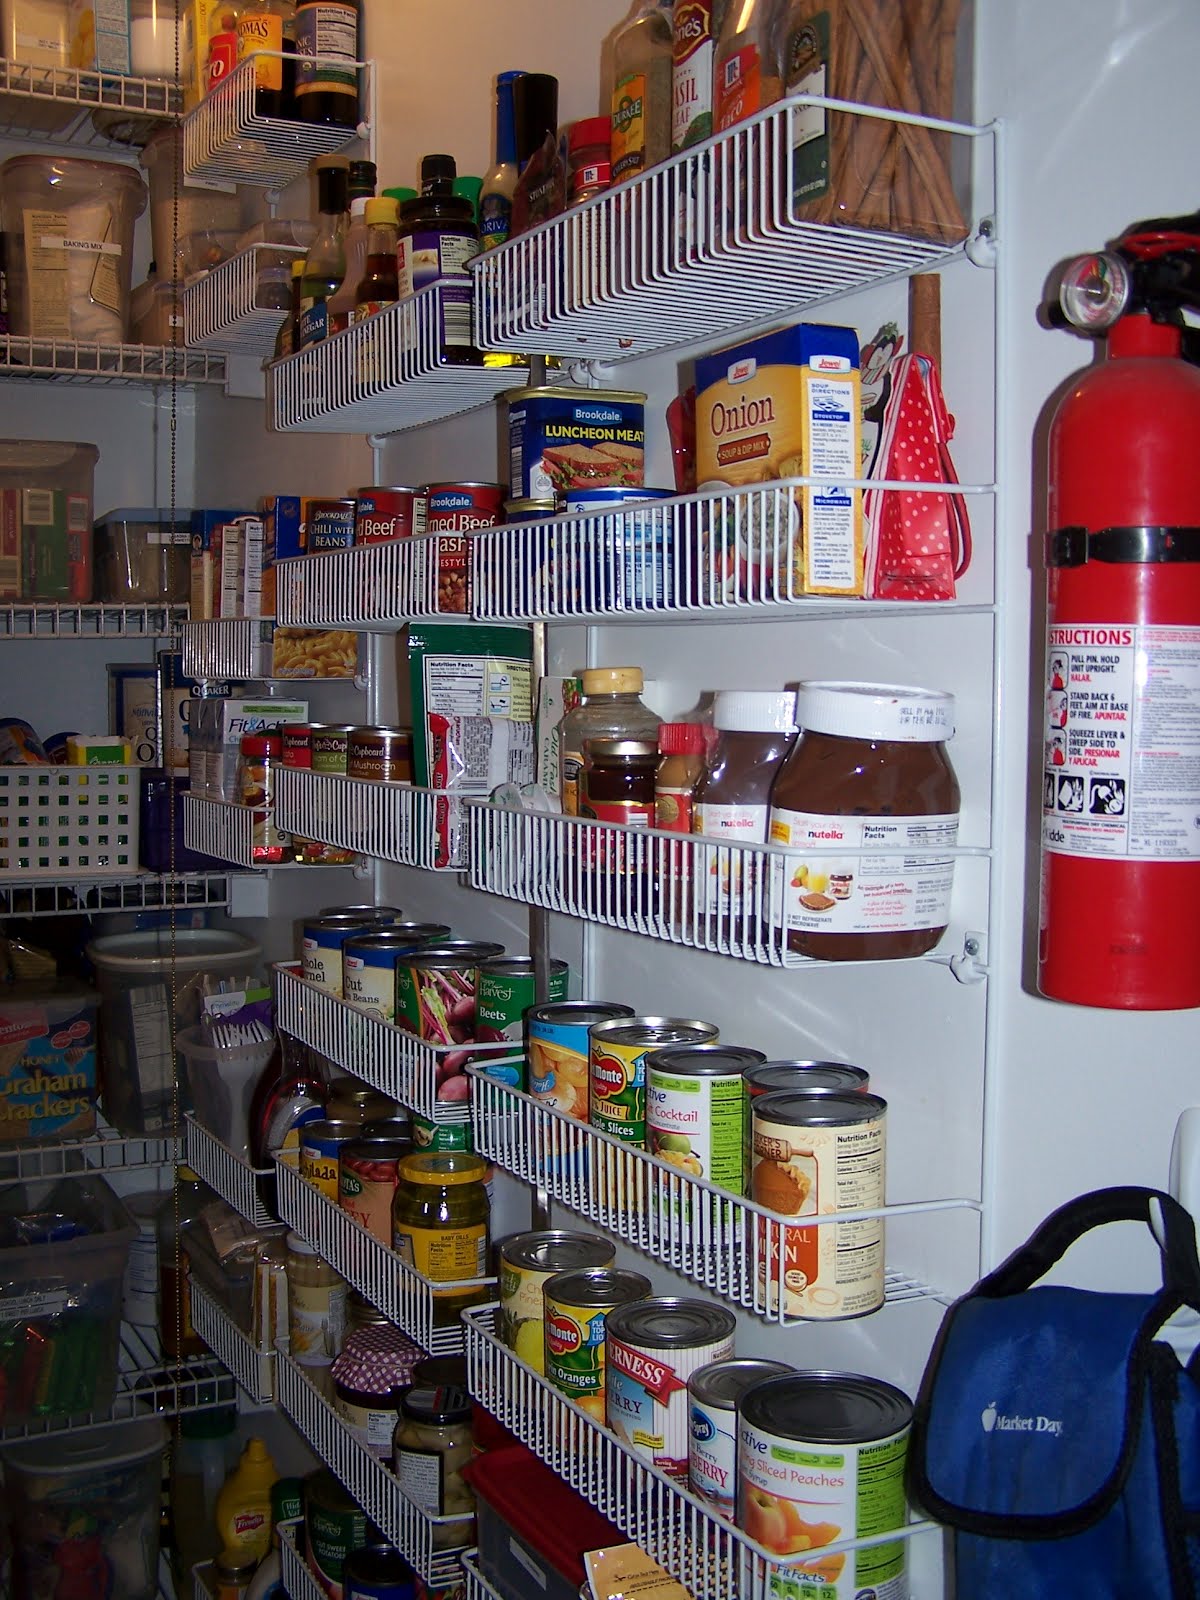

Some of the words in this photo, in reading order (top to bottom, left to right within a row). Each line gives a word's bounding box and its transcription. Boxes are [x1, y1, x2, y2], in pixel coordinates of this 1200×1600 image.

[613, 100, 641, 128] DURKEE
[63, 241, 89, 249] BAKING
[819, 358, 841, 368] Jewel
[575, 408, 621, 422] Brookdale
[711, 396, 775, 437] Onion
[545, 425, 614, 440] LUNCHEON
[721, 448, 736, 459] SOUP
[741, 446, 752, 454] DIP
[753, 442, 765, 452] MIX
[430, 496, 471, 508] Brookdale
[815, 498, 850, 506] MICROWAVE
[310, 524, 331, 535] CHILI
[365, 518, 396, 535] Beef
[460, 514, 496, 531] Beef
[315, 535, 345, 546] BEANS
[1071, 655, 1084, 663] PULL
[1086, 665, 1116, 674] UPRIGHT.
[1094, 712, 1126, 721] APUNTAR.
[1069, 729, 1095, 738] SQUEEZE
[1096, 730, 1118, 738] LEVER
[551, 726, 560, 757] Old
[354, 745, 384, 757] Cupboard
[1084, 749, 1120, 758] PRESIONAR
[354, 761, 396, 770] Mushroom
[808, 830, 843, 839] nutella
[346, 976, 362, 991] Cut
[353, 993, 379, 1003] Beans
[480, 1007, 506, 1021] Beets
[600, 1101, 622, 1116] JUICE
[655, 1106, 698, 1122] Cocktail
[607, 1122, 634, 1136] Slices
[838, 1133, 868, 1142] Nutrition
[609, 1342, 665, 1386] ERNESS
[558, 1368, 596, 1387] Oranges
[995, 1415, 1033, 1430] Market
[1035, 1416, 1063, 1437] Day
[696, 1444, 717, 1464] Berry
[859, 1444, 890, 1455] Nutrition
[757, 1459, 786, 1480] Sliced
[791, 1470, 844, 1486] Peaches
[327, 1544, 346, 1552] SWEET
[776, 1565, 790, 1578] Fit
[792, 1570, 825, 1583] Facts
